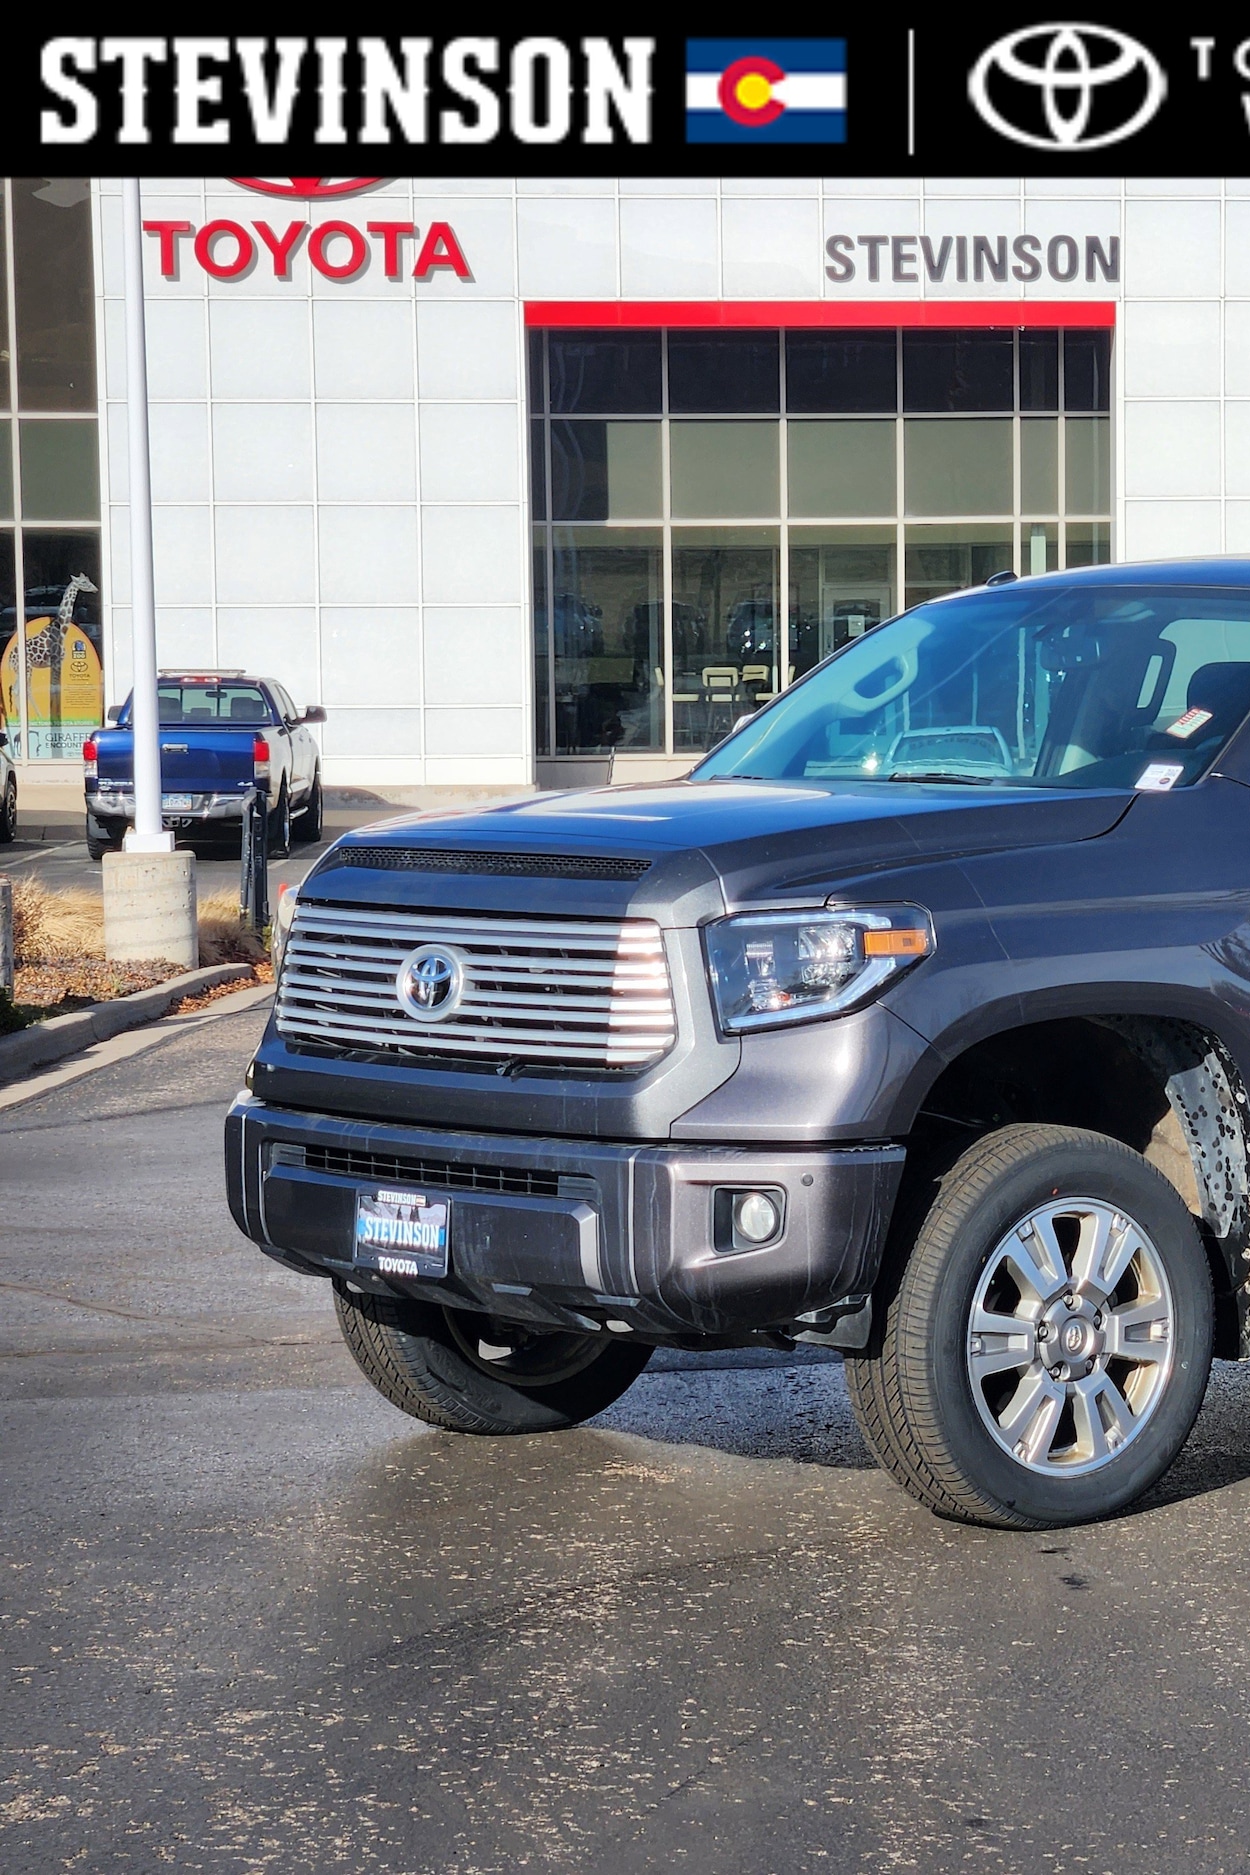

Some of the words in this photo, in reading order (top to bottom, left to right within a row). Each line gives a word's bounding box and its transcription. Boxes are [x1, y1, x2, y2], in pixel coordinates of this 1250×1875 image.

[142, 220, 473, 282] TOYOTA
[825, 234, 1121, 283] STEVINSON
[377, 1190, 417, 1206] STEVINSON
[364, 1217, 440, 1248] STEVINSON
[377, 1256, 419, 1275] TOYOTA
